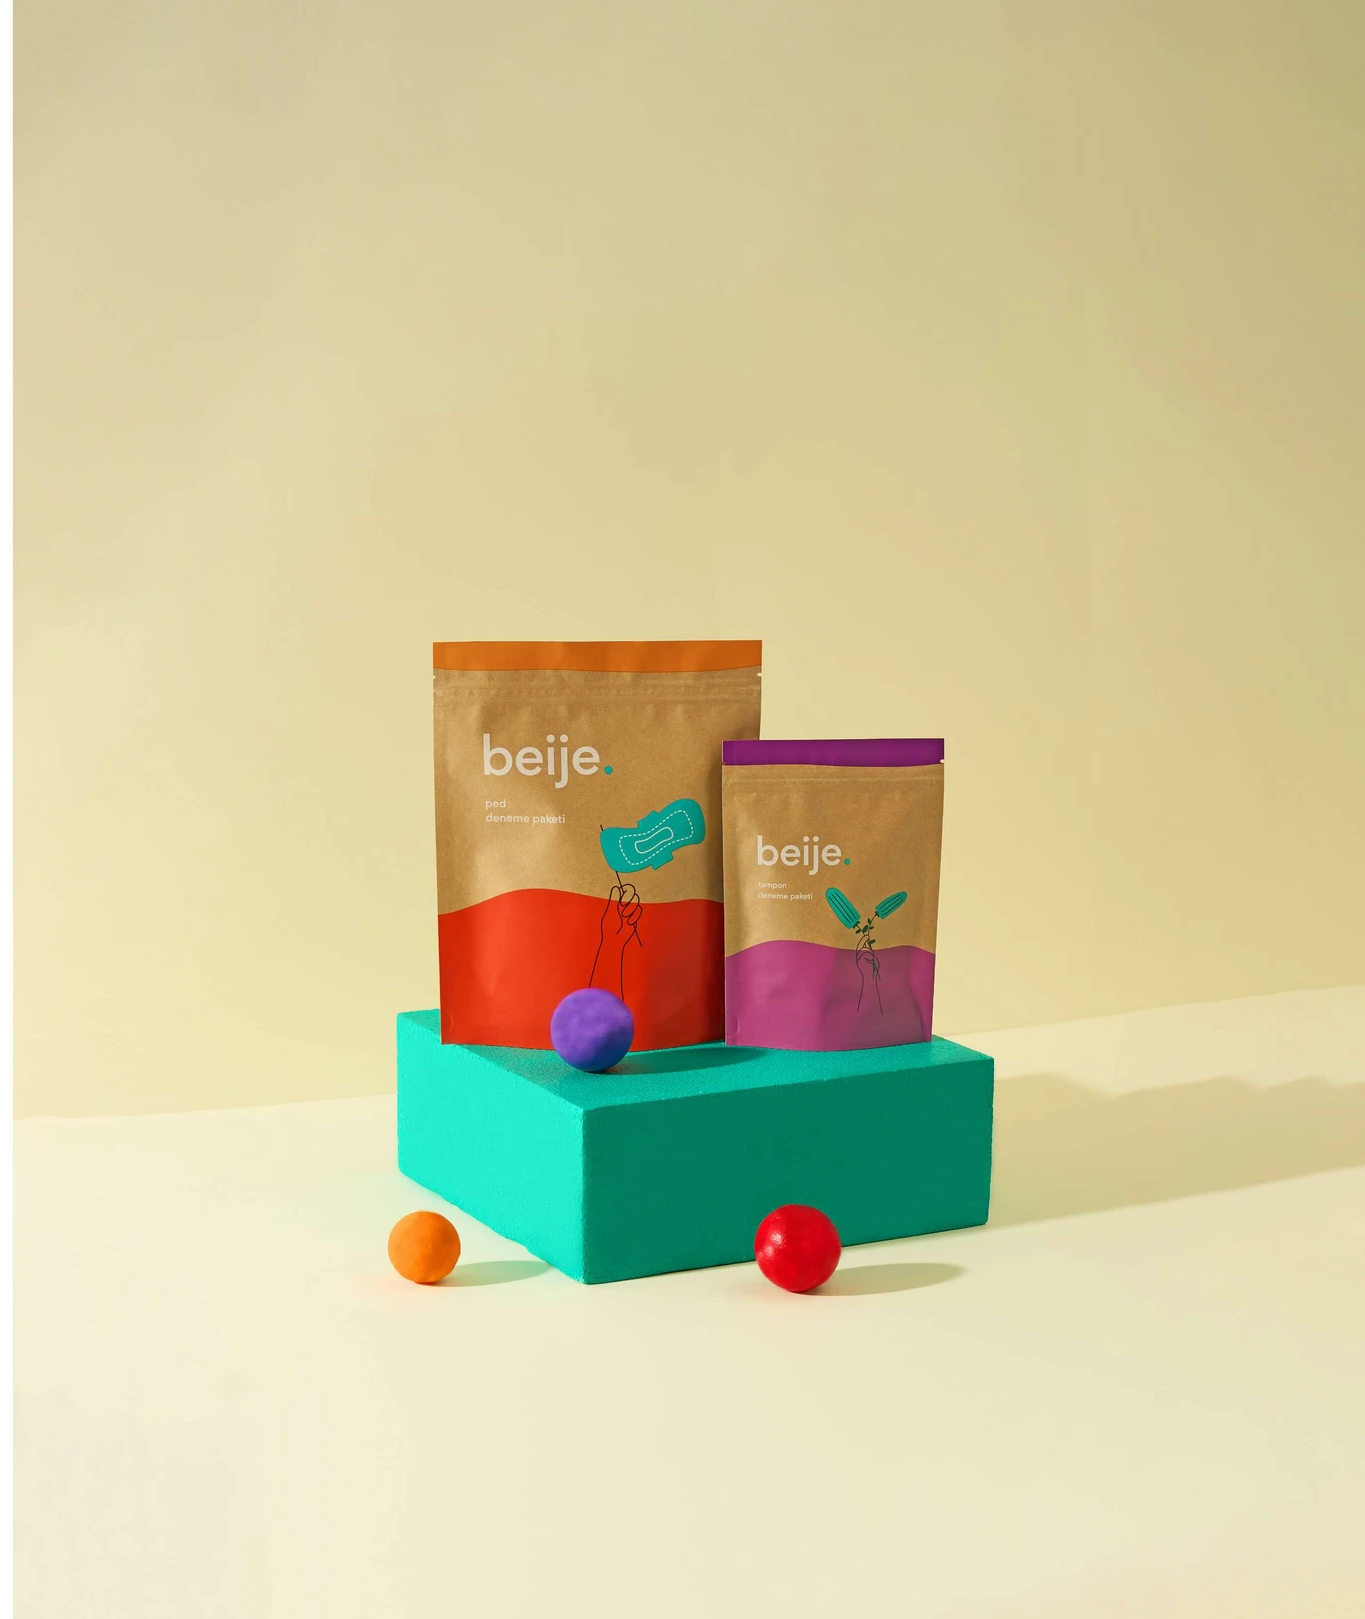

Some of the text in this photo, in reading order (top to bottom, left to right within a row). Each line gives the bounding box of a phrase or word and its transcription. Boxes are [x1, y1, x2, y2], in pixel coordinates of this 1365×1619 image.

[483, 733, 613, 789] beije.
[485, 799, 506, 810] ped
[486, 813, 565, 825] deneme paketi
[757, 835, 851, 876] beije.
[758, 882, 787, 890] tampon
[790, 893, 813, 901] paketi
